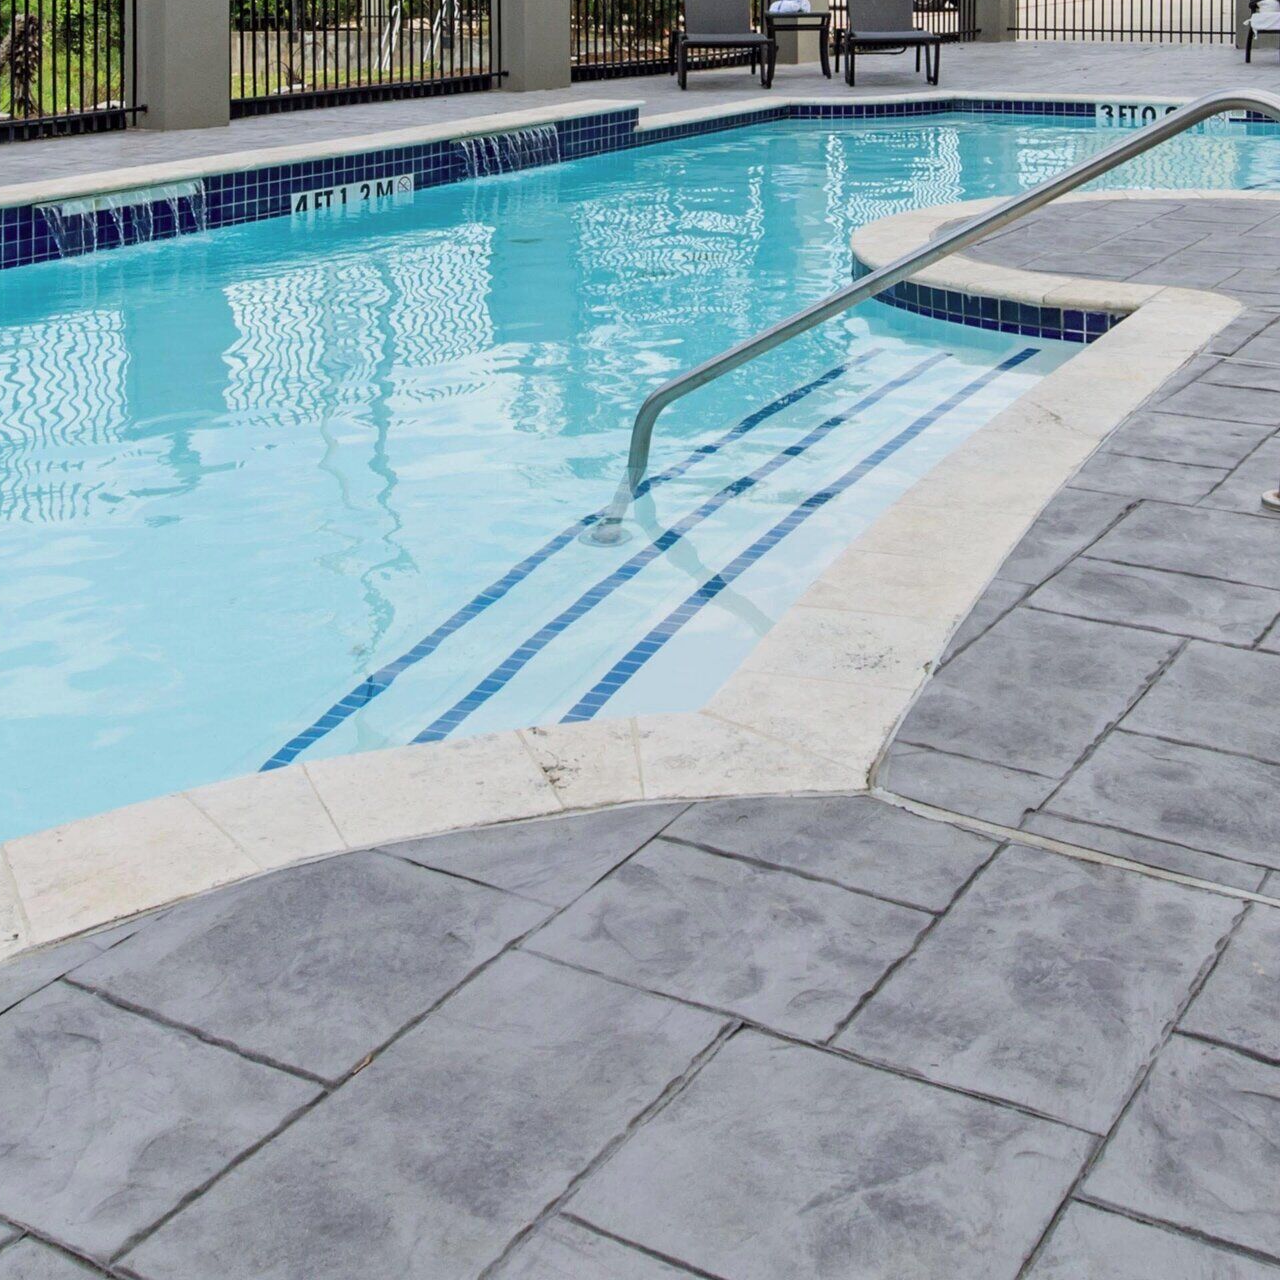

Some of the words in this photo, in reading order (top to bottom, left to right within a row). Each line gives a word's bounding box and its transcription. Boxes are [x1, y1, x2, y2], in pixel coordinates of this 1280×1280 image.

[1100, 105, 1114, 119] 3
[1119, 105, 1138, 119] FT
[295, 194, 308, 213] 4
[314, 189, 333, 210] FT
[377, 180, 394, 198] M
